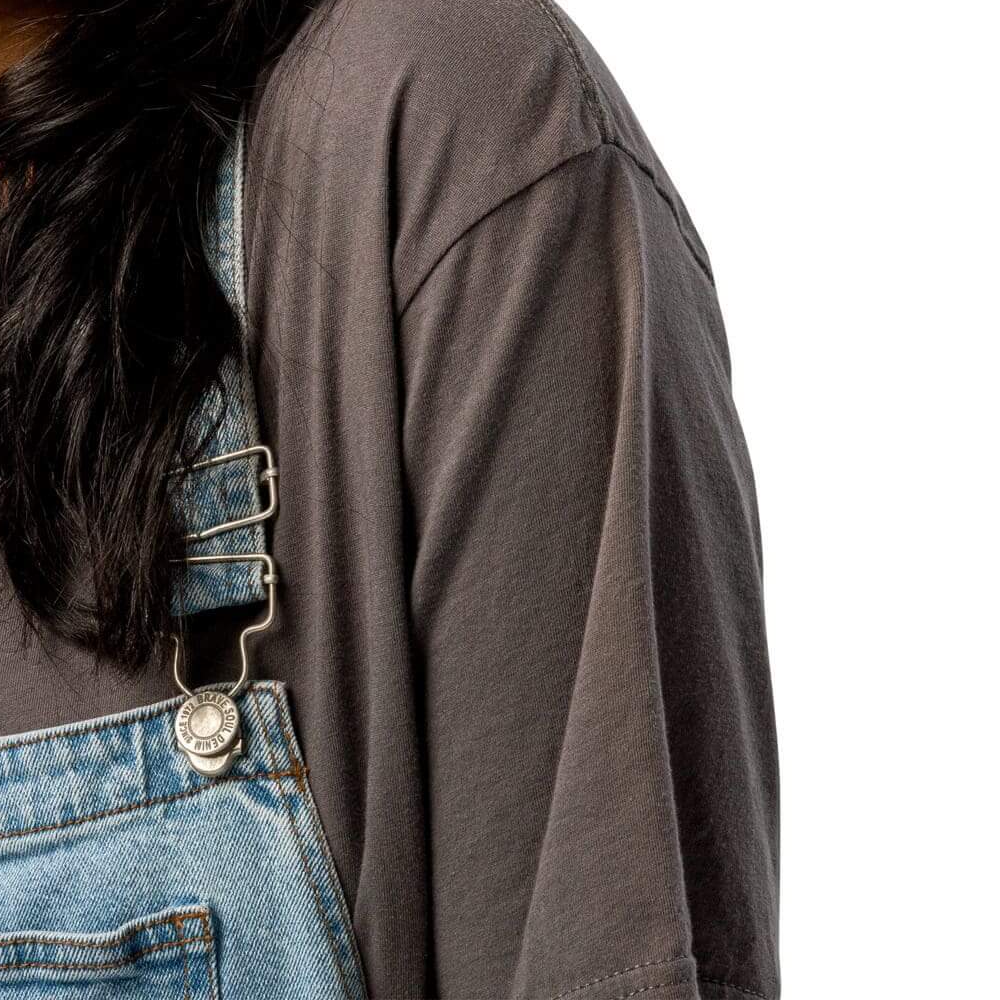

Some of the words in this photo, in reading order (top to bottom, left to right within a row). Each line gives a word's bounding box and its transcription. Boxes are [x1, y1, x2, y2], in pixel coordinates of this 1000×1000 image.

[196, 692, 230, 708] BRAVE
[222, 707, 236, 733] SOUL
[194, 735, 225, 751] DENIM
